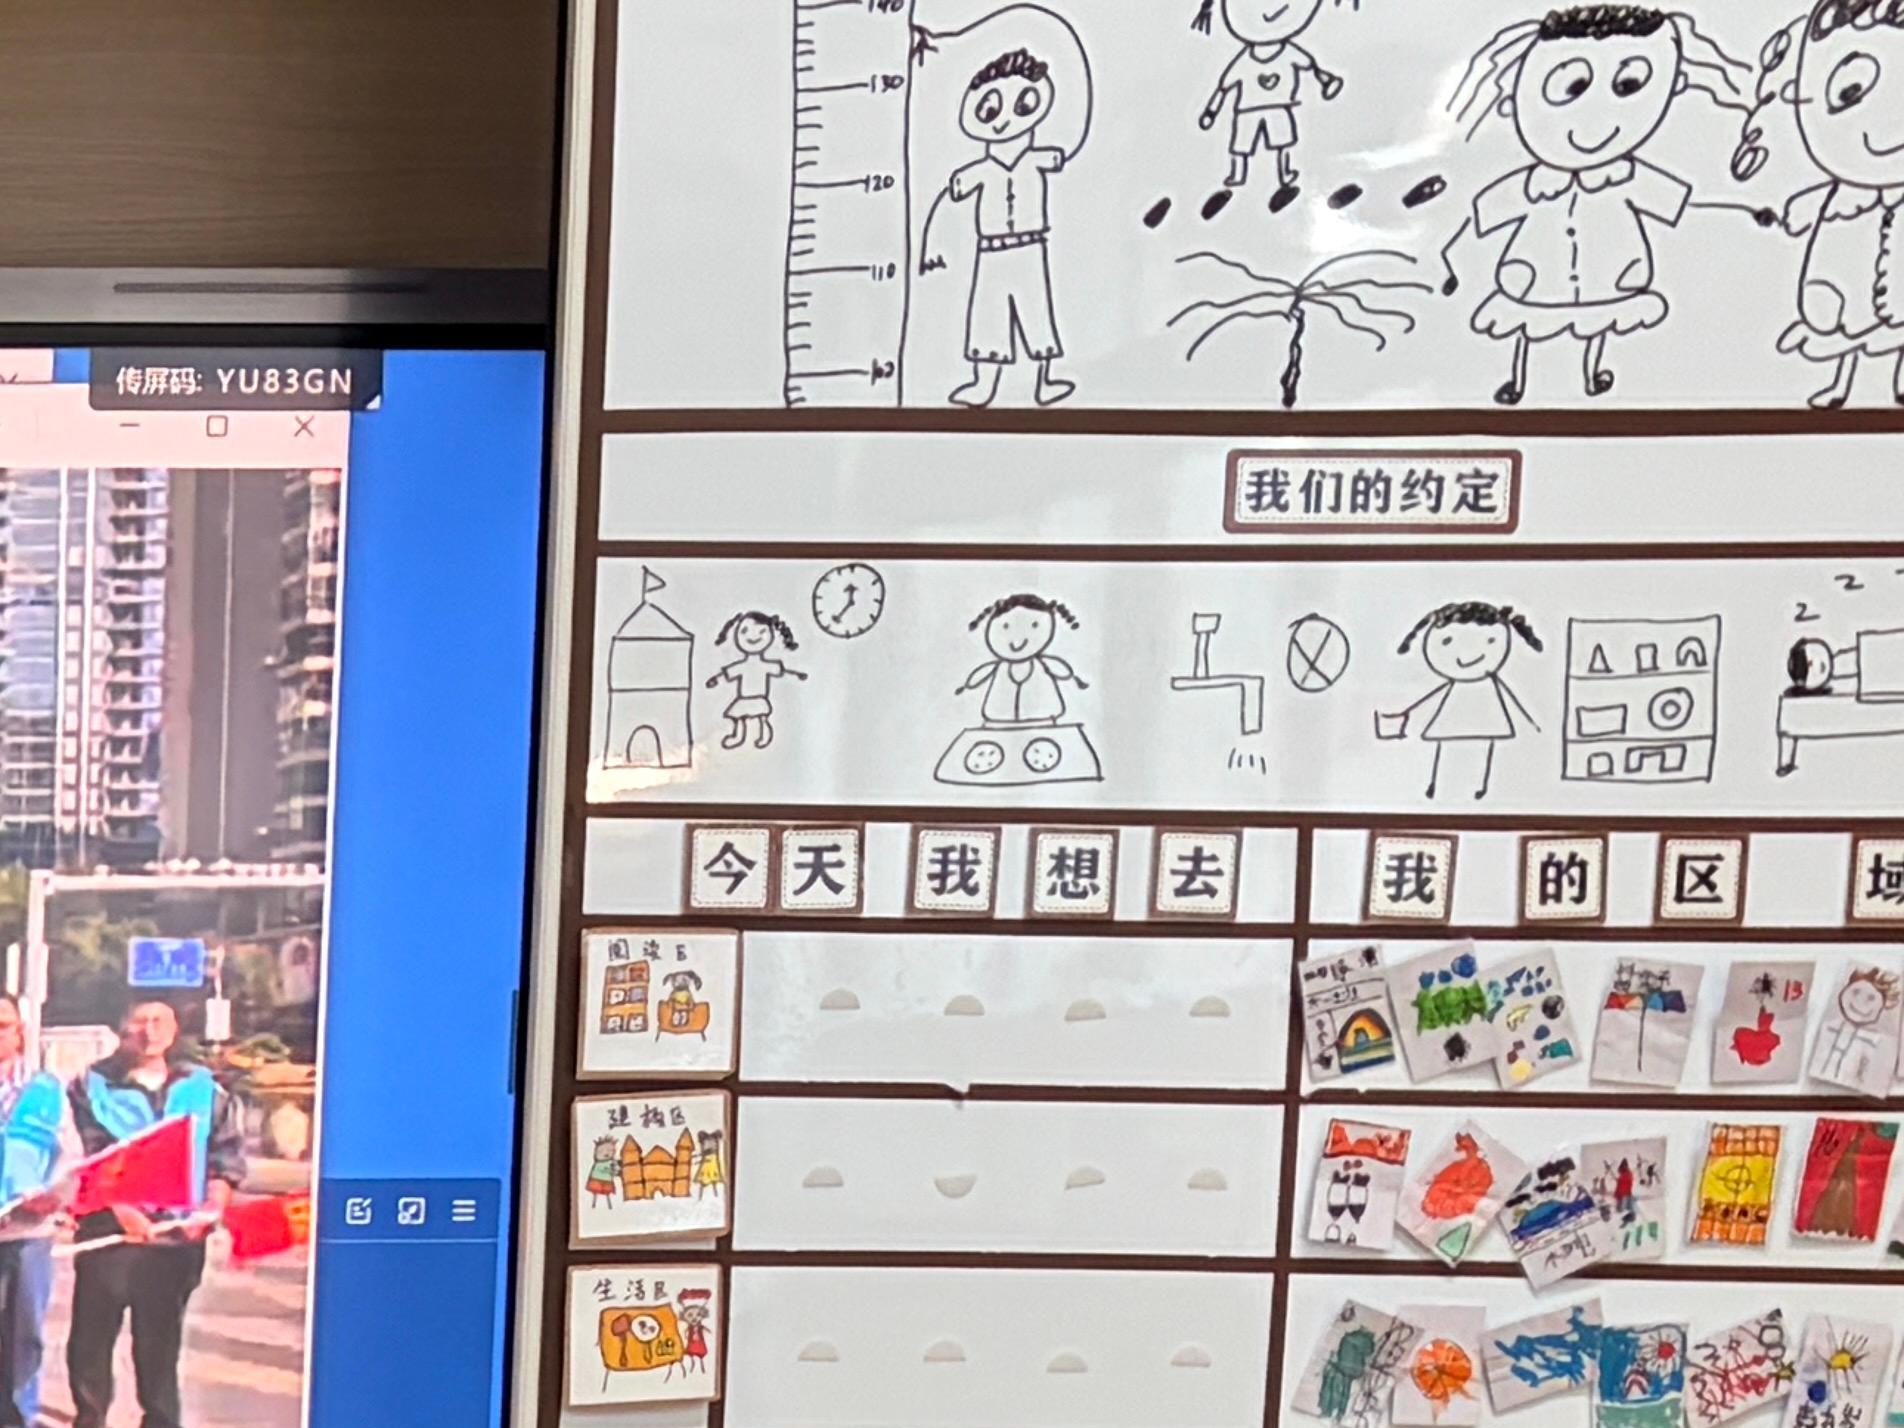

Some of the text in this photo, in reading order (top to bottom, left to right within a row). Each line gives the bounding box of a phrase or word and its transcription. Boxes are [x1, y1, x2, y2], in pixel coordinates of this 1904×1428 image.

[871, 73, 905, 94] 130
[865, 174, 895, 193] 120
[872, 262, 897, 281] 110
[116, 367, 352, 396] 传屏码: YU83GN
[1245, 467, 1500, 515] 我们的约定
[702, 840, 1226, 899] 今天我想去
